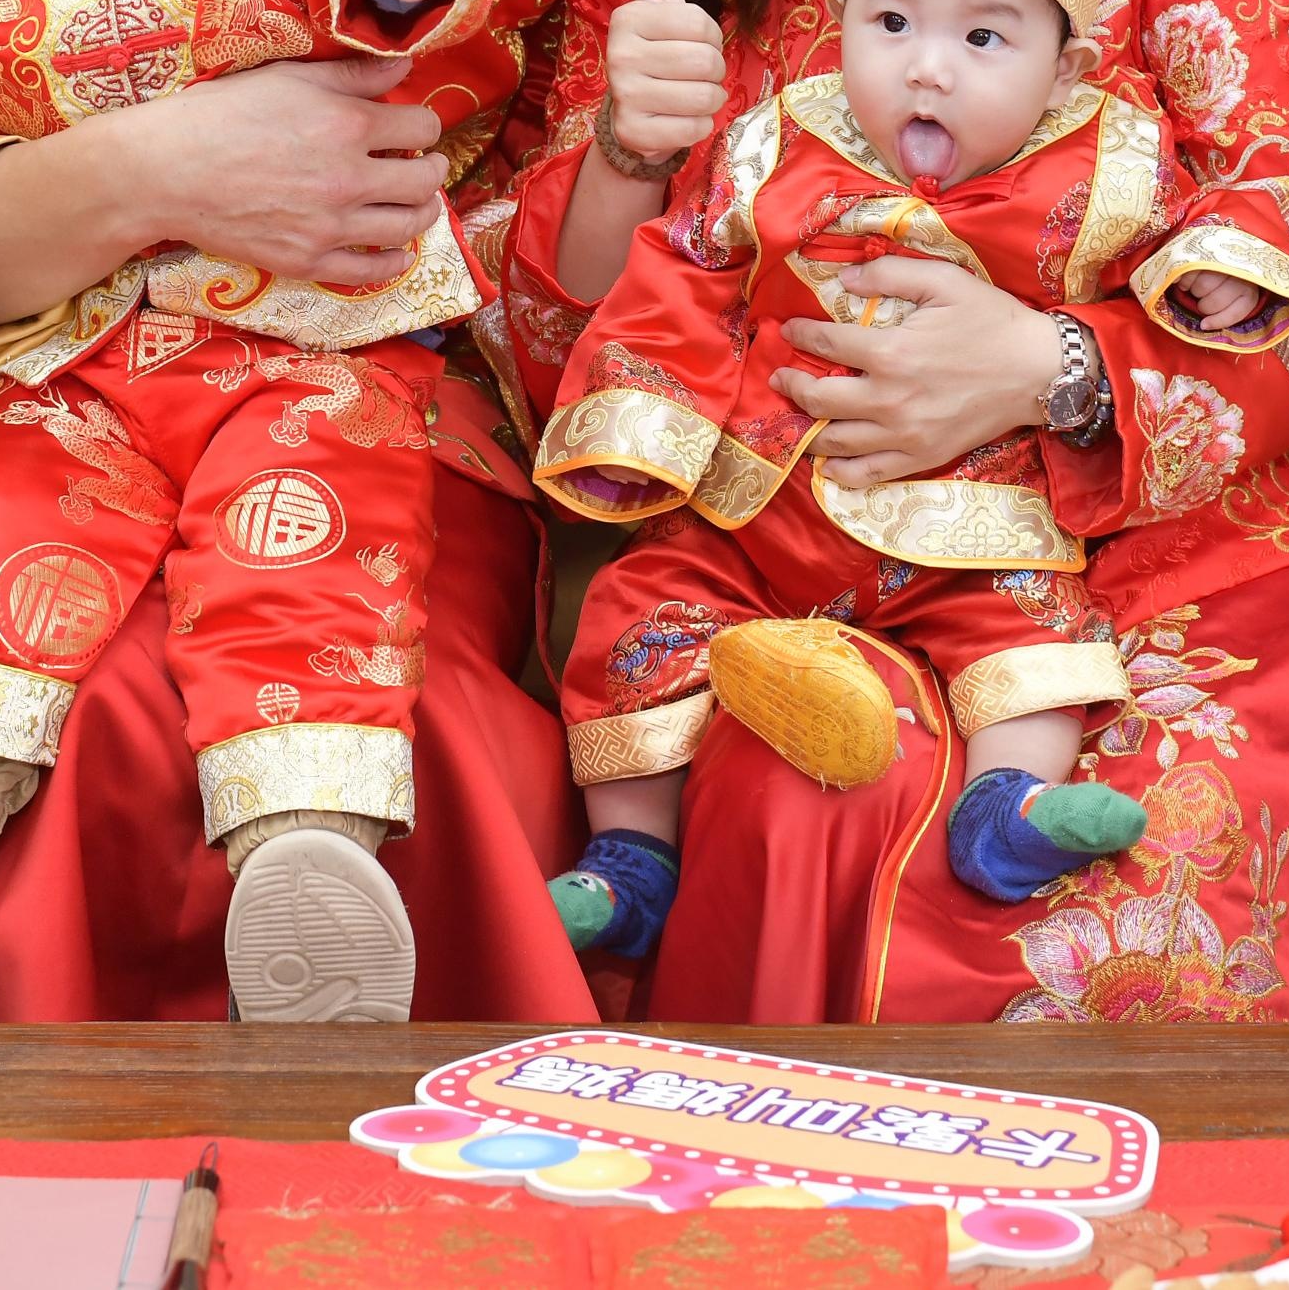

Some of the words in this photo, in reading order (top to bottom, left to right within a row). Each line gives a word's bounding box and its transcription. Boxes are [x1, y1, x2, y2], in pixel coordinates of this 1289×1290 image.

[501, 1054, 1101, 1170] 卡緊叫媽媽
